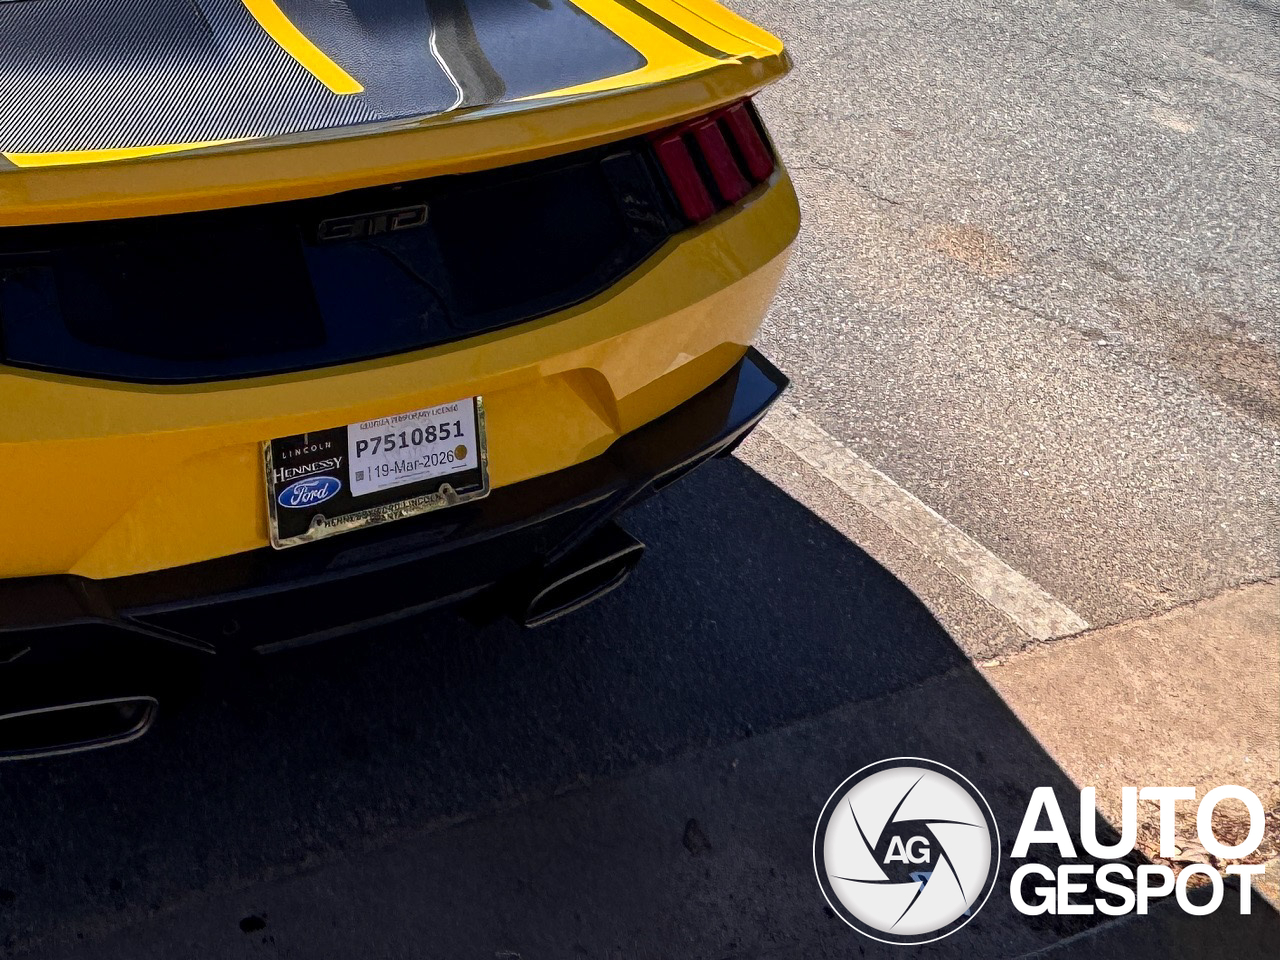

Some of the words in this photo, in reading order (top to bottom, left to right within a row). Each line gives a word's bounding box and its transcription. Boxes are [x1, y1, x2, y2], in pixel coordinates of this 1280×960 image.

[282, 441, 332, 460] LINCOLN
[355, 420, 465, 458] P7510851
[273, 456, 343, 484] HENNESSY
[374, 450, 455, 478] 19-Mar-2026
[290, 480, 329, 506] Ford
